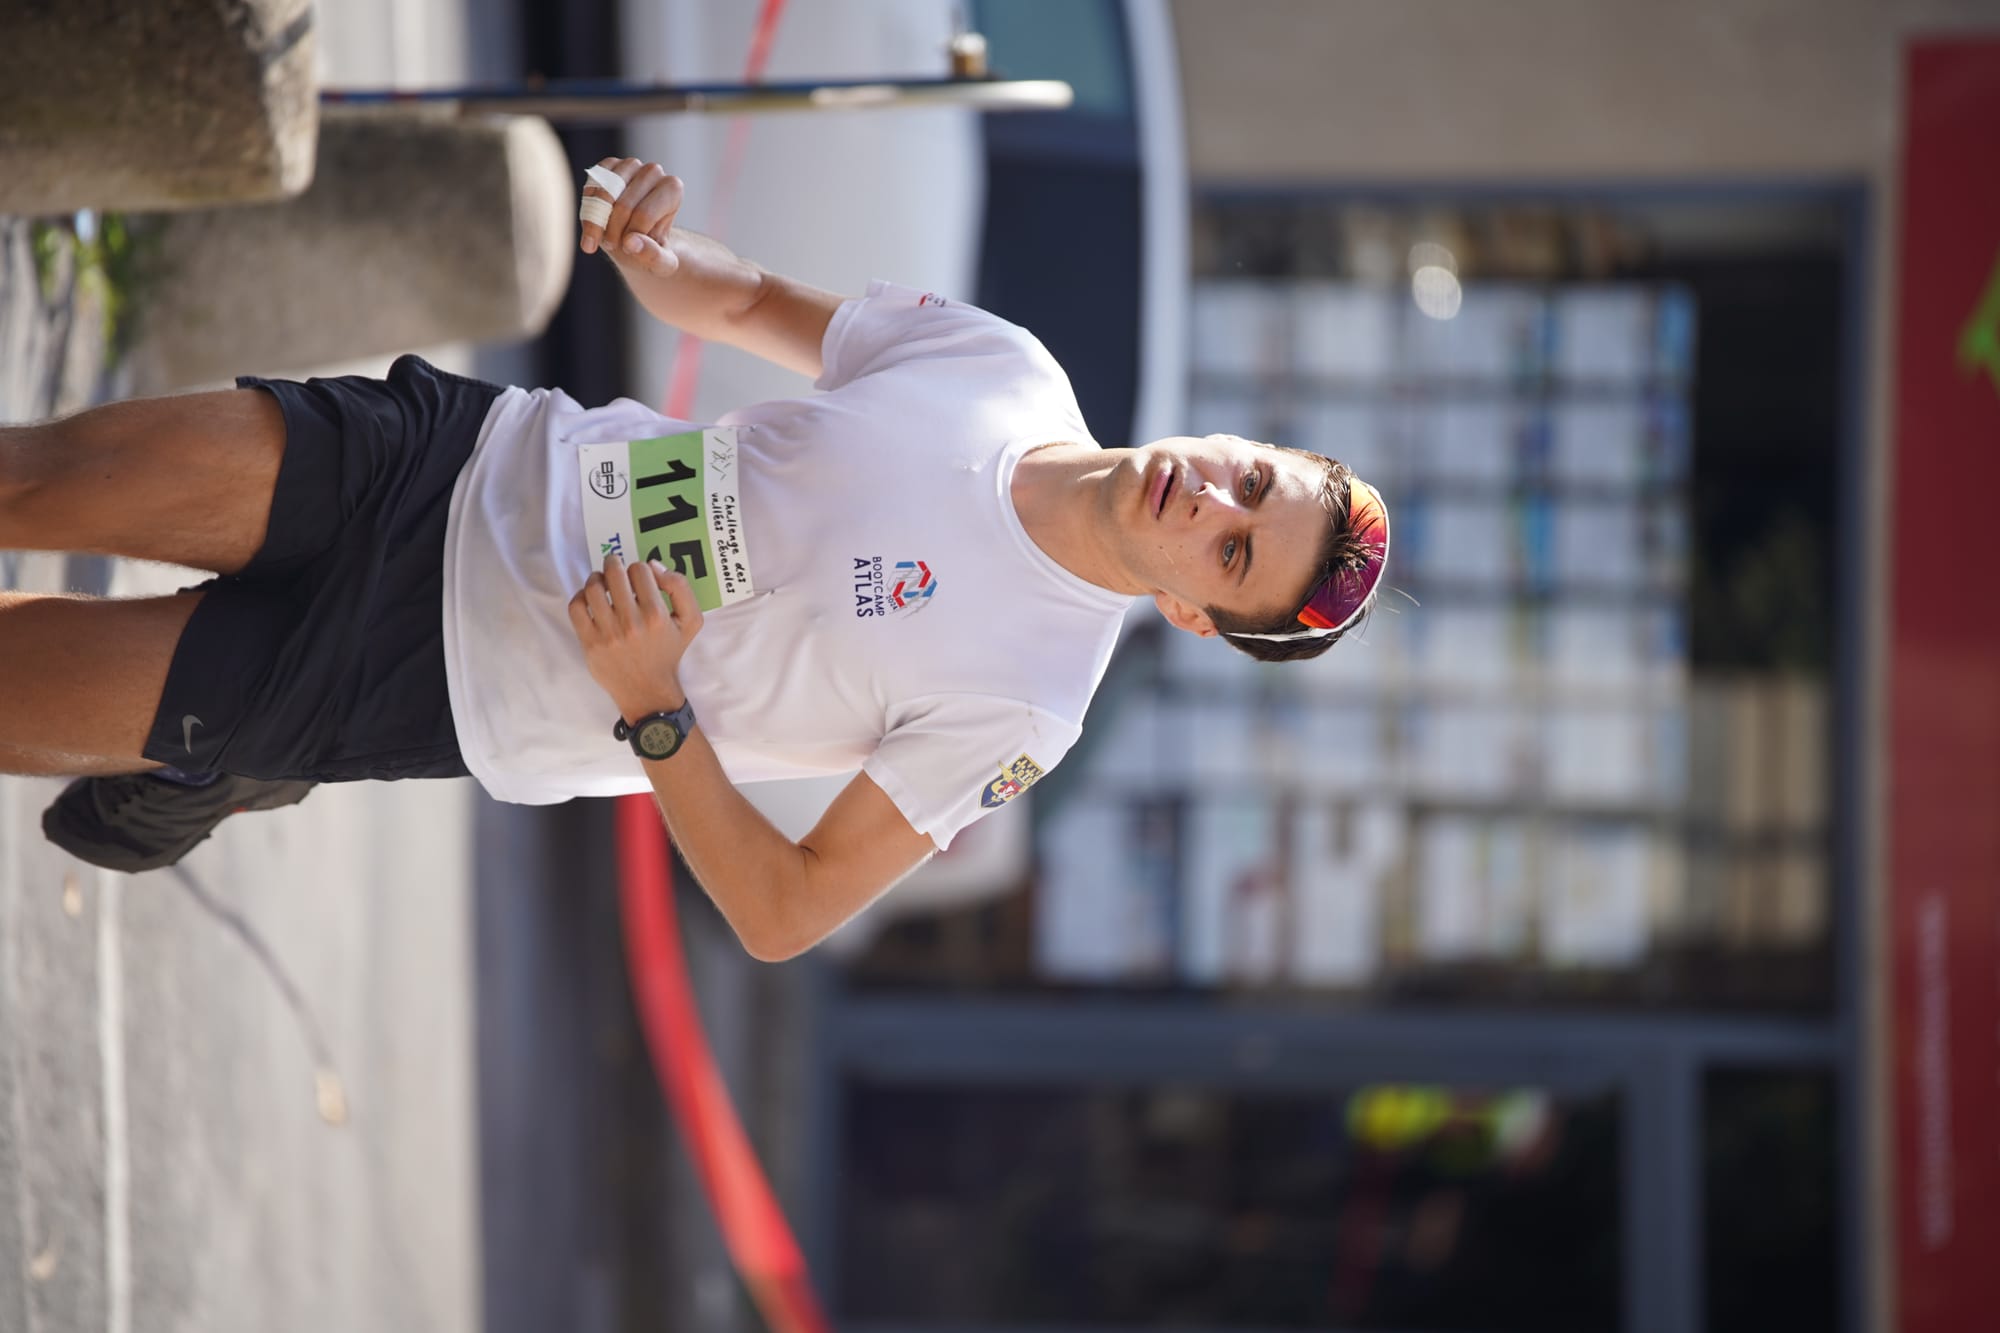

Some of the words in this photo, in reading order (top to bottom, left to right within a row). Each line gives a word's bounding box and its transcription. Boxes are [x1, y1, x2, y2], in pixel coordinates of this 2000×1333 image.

[602, 461, 614, 495] BFP
[636, 459, 708, 580] 115
[711, 492, 723, 532] vallées
[717, 540, 734, 593] cévenoles
[723, 496, 739, 555] Challenge
[735, 563, 746, 583] des
[854, 558, 873, 617] ATLAS
[872, 556, 885, 617] BOOTCAMP
